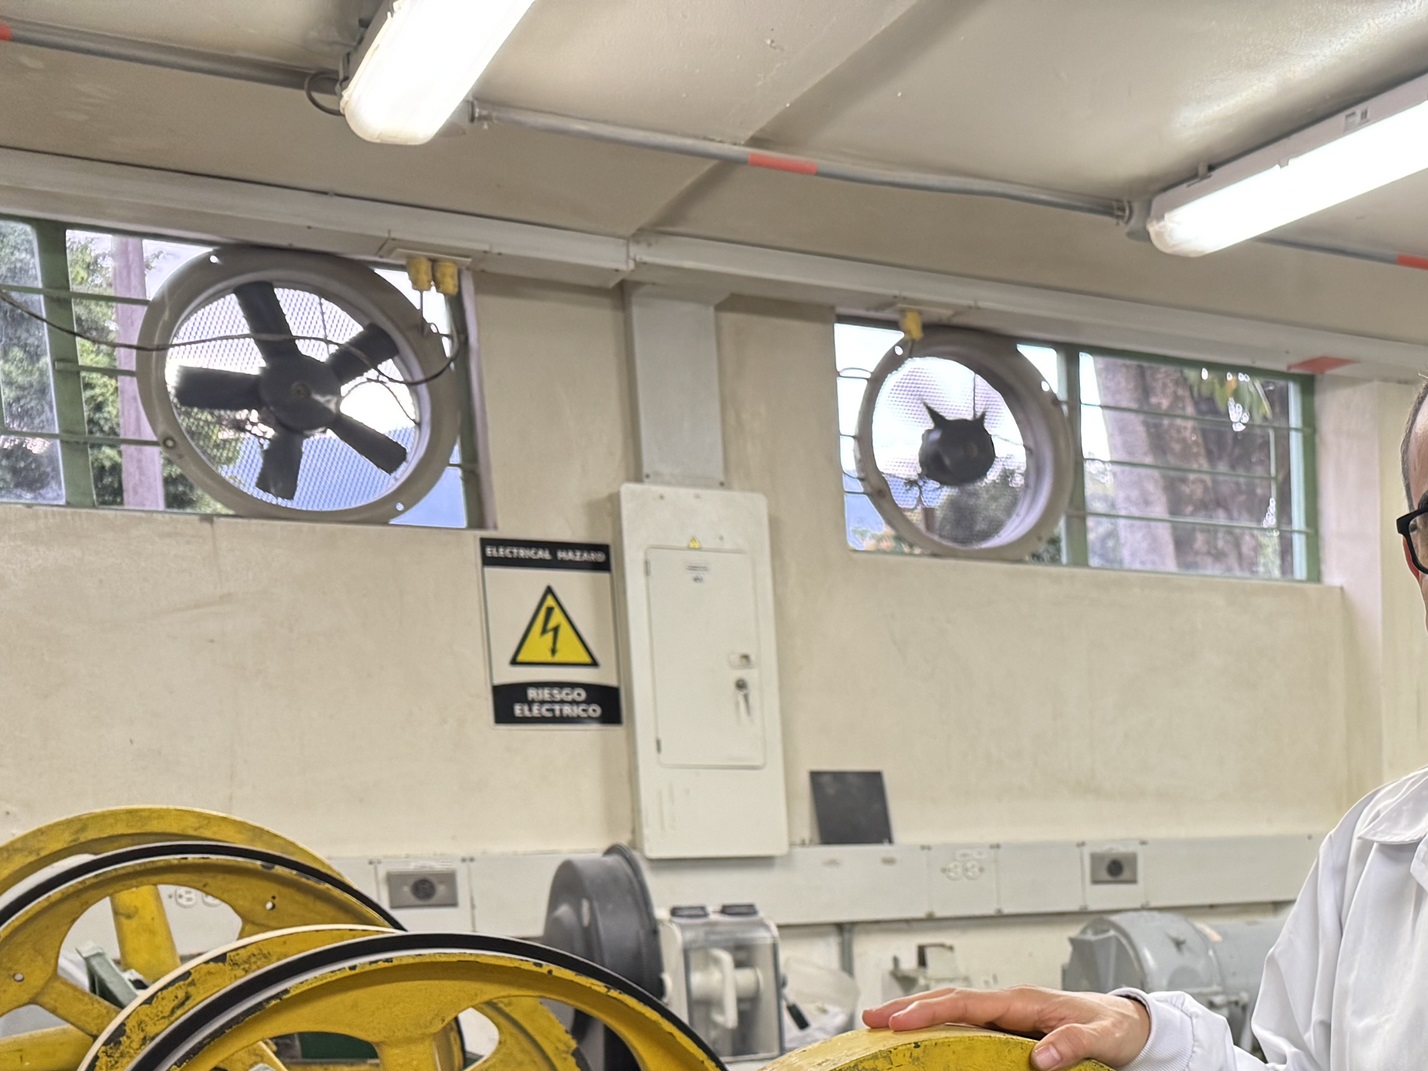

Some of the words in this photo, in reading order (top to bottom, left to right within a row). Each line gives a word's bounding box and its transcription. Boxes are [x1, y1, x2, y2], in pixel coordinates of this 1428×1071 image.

[485, 545, 552, 560] ELECTRICAL
[556, 549, 606, 562] HAZARD
[526, 687, 587, 702] RIESGO
